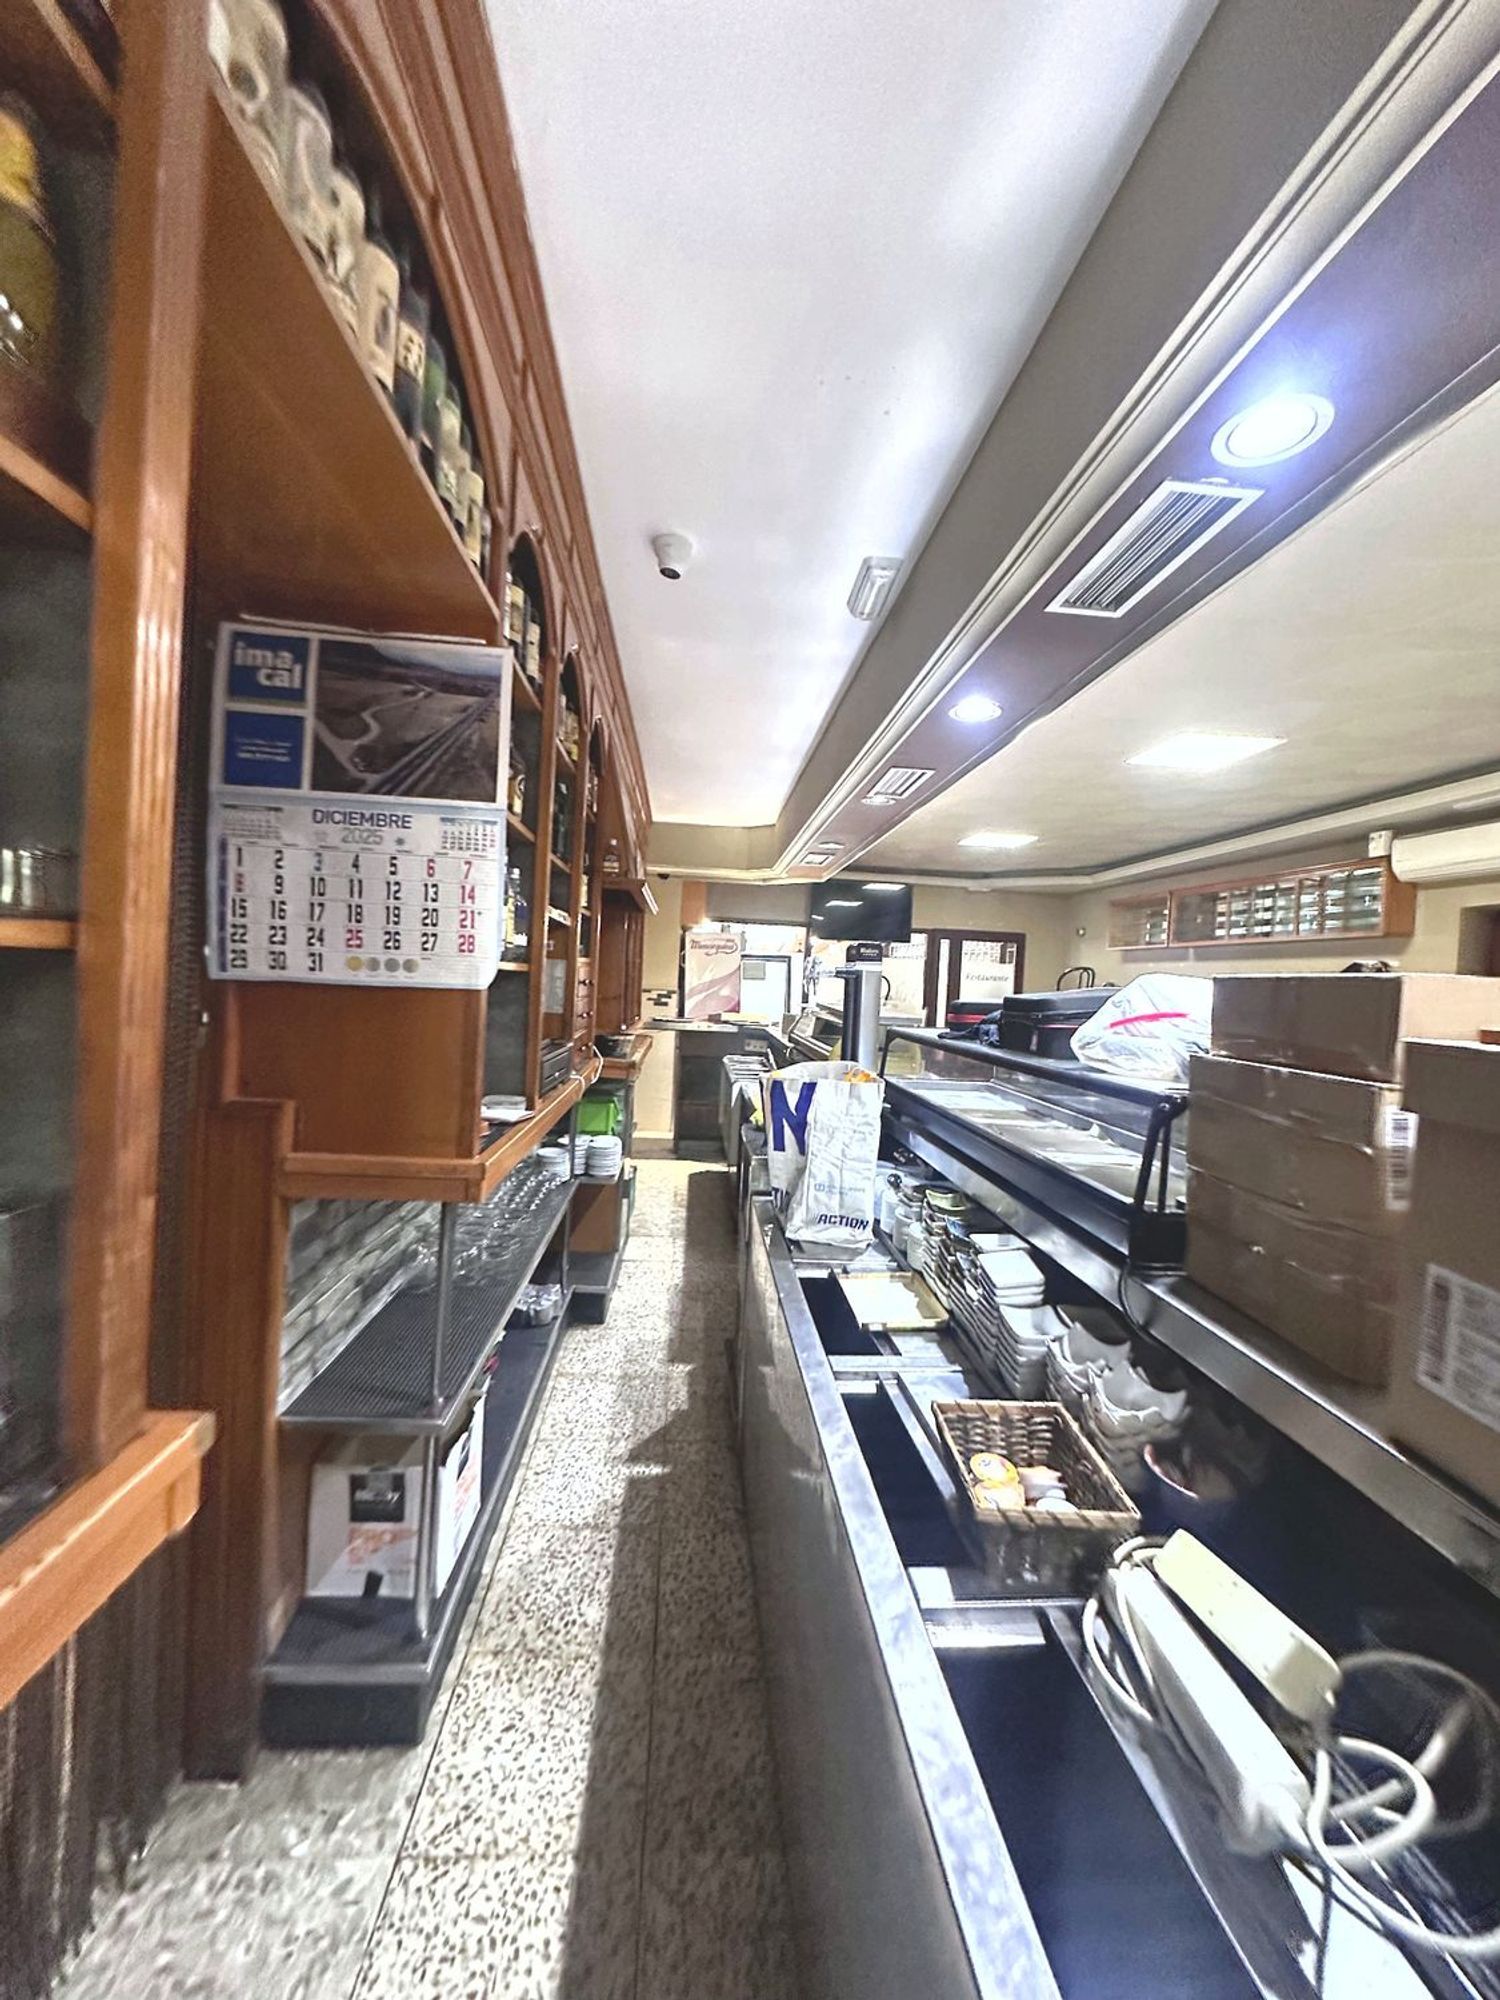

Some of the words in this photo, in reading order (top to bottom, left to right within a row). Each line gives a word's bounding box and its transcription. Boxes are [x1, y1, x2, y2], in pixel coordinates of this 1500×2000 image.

[257, 663, 302, 689] cal
[312, 808, 413, 830] DICIEMBRE
[341, 827, 384, 846] 2025
[237, 847, 242, 867] 1
[275, 850, 284, 869] 2
[352, 853, 360, 873] 4
[389, 856, 398, 876] 5
[427, 858, 436, 878] 6
[464, 861, 472, 880] 7
[275, 875, 284, 895] 9
[310, 877, 326, 897] 10
[349, 878, 363, 899] 11
[386, 881, 401, 901] 12
[424, 883, 439, 902] 13
[461, 885, 475, 905] 14
[232, 898, 247, 918] 15
[271, 900, 287, 920] 16
[310, 902, 325, 922] 17
[348, 904, 363, 924] 18
[385, 905, 400, 926] 19
[422, 908, 439, 927] 20
[459, 910, 475, 929] 21
[230, 923, 248, 944] 22
[269, 925, 287, 945] 23
[307, 927, 324, 947] 24
[346, 929, 363, 949] 25
[384, 931, 401, 950] 26
[421, 932, 438, 951] 27
[458, 934, 475, 953] 28
[268, 951, 287, 971] 30
[308, 952, 323, 972] 31
[817, 1213, 869, 1231] ACTION
